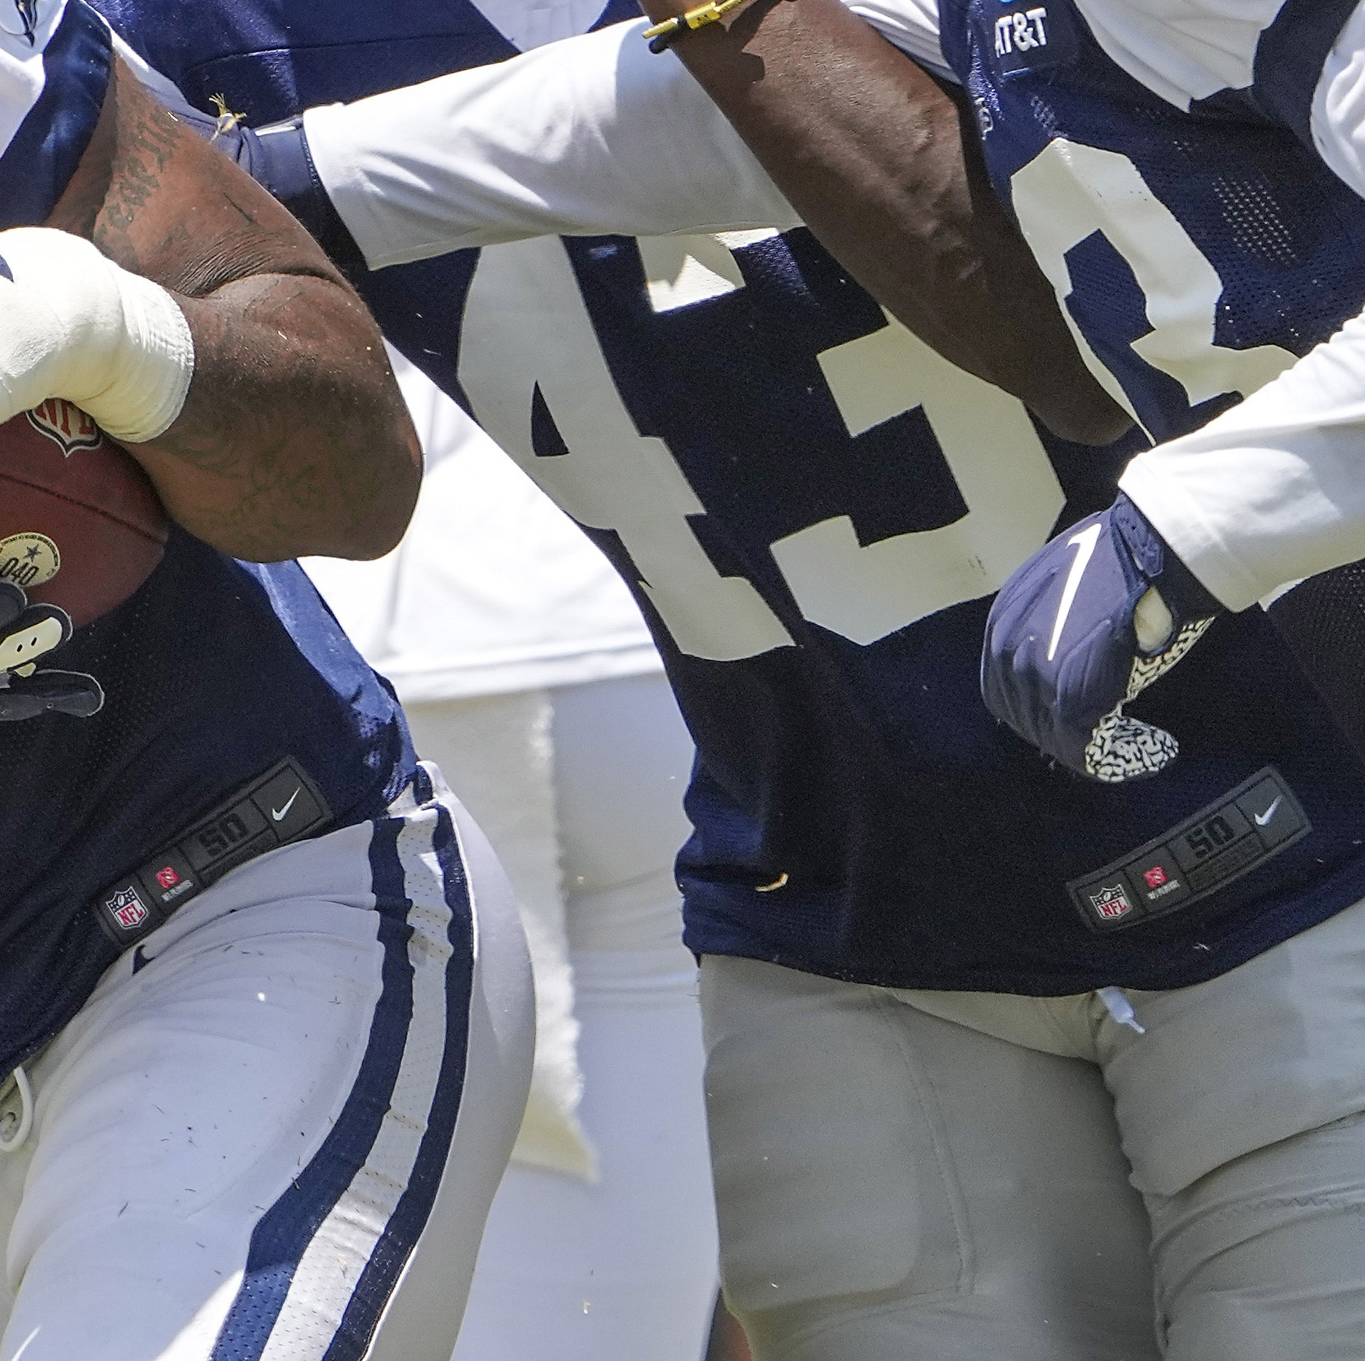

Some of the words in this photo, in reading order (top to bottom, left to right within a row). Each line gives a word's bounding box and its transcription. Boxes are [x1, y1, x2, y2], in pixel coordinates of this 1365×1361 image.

[995, 7, 1047, 59] AT&T
[1186, 816, 1235, 859] 50
[117, 903, 145, 926] NFL
[1100, 899, 1127, 916] NFL
